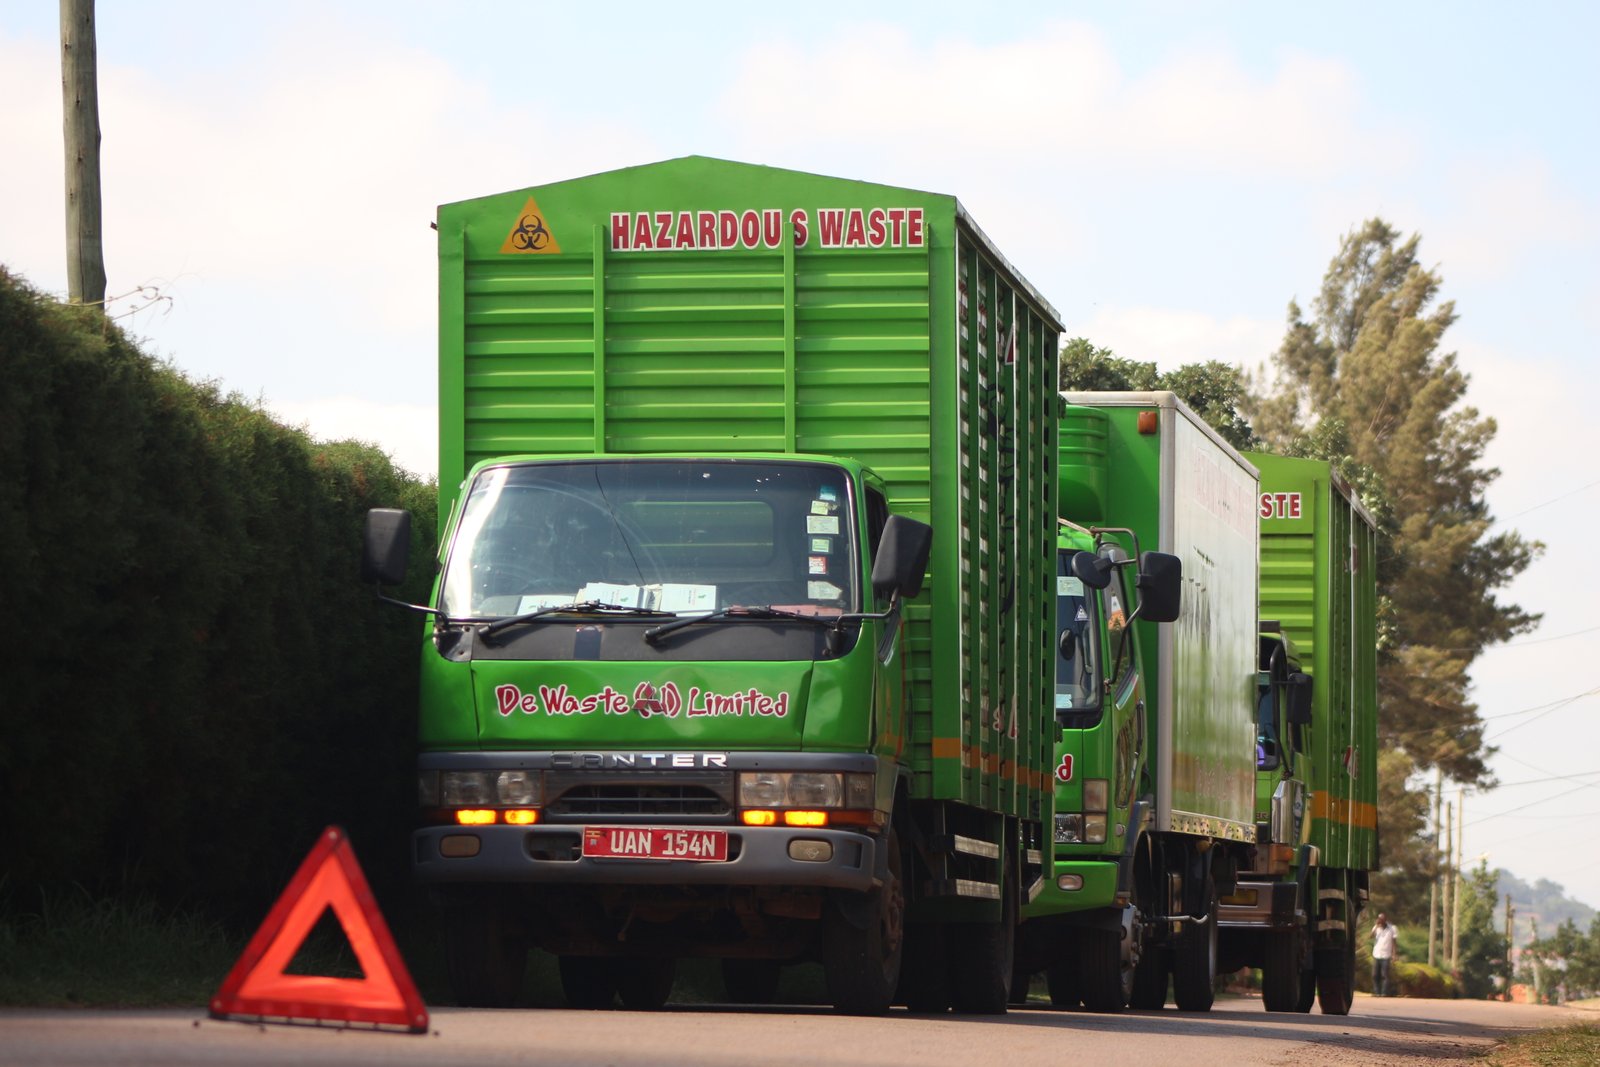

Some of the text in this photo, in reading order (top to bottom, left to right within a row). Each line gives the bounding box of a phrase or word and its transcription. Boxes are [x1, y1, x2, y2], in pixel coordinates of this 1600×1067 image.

[610, 207, 924, 252] HAZARDOUS WASTE
[495, 684, 538, 716] De
[539, 684, 630, 716] Waste
[686, 687, 789, 718] Limited
[551, 753, 728, 768] CANTER
[610, 831, 716, 857] UAN 154N
